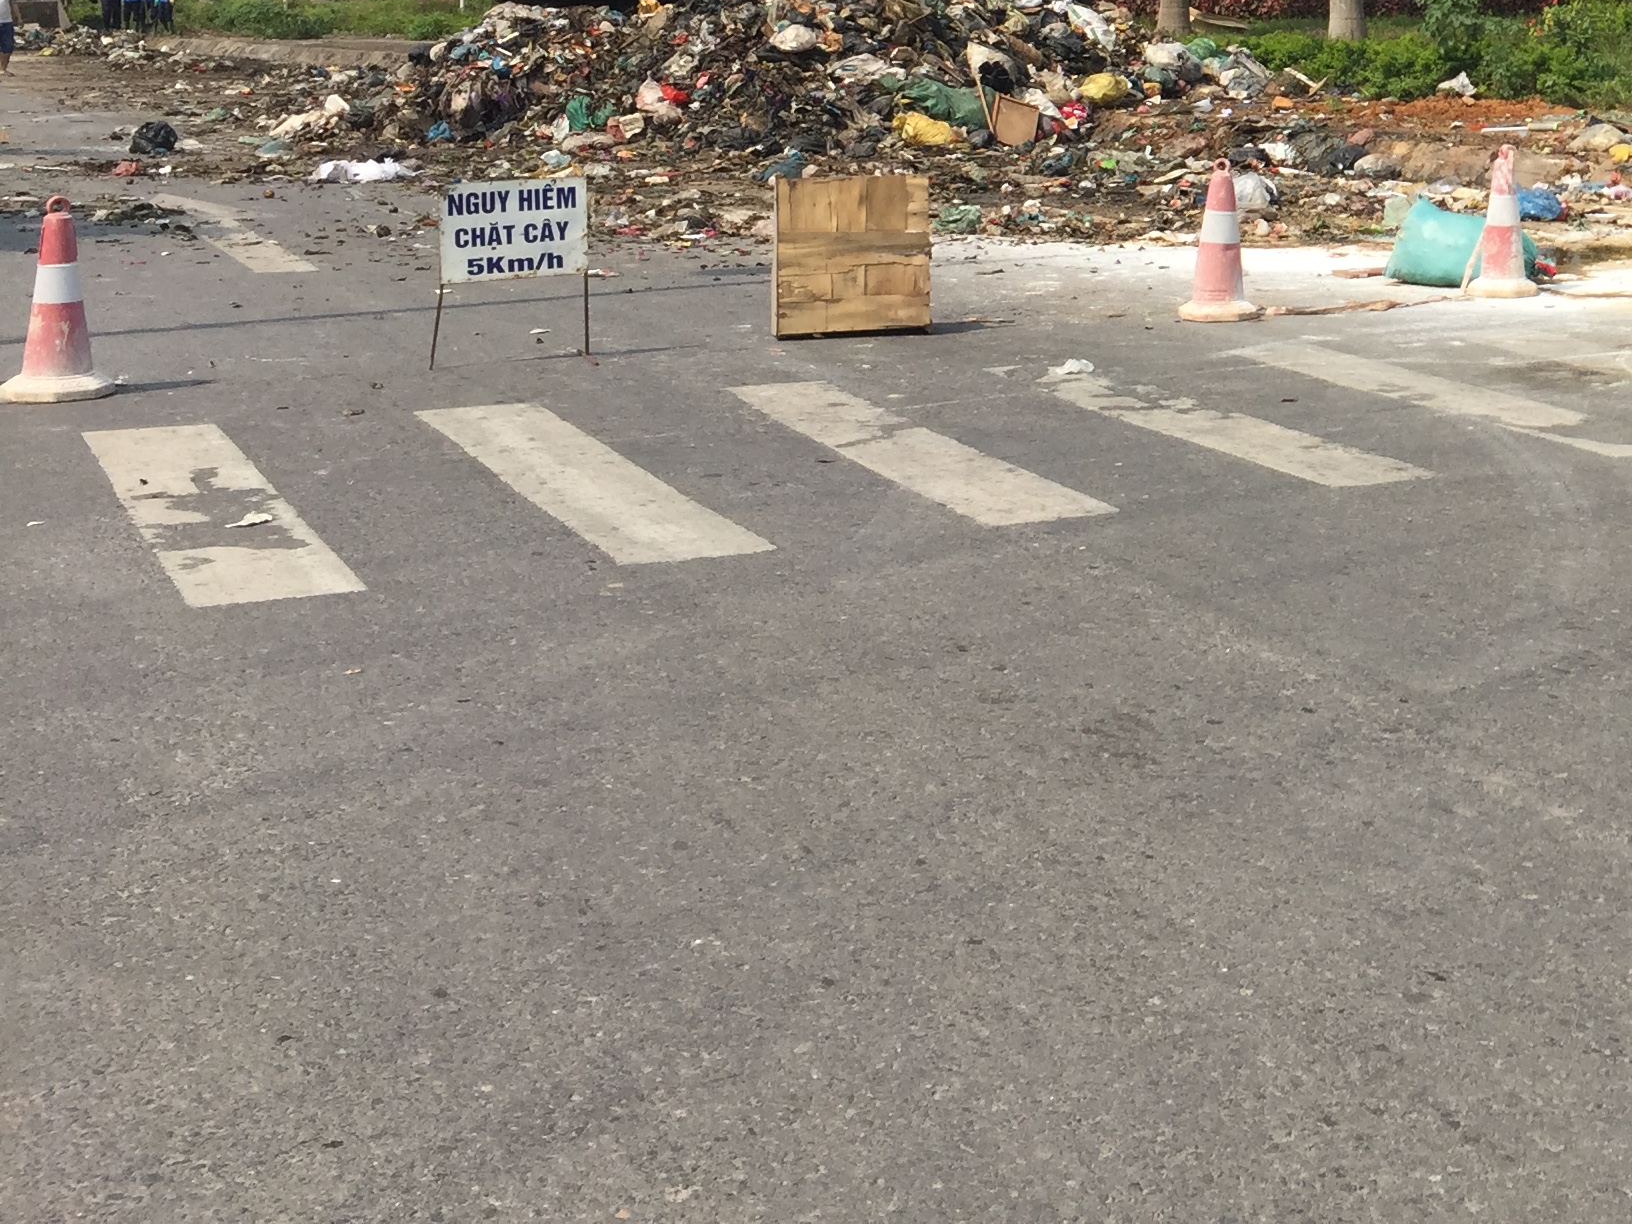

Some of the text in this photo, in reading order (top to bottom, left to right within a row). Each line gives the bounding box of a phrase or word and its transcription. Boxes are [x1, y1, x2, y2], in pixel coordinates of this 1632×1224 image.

[447, 180, 577, 216] NGUY HIỂM
[454, 218, 569, 250] CHẶT CÂY
[467, 252, 564, 276] 5Km/h
